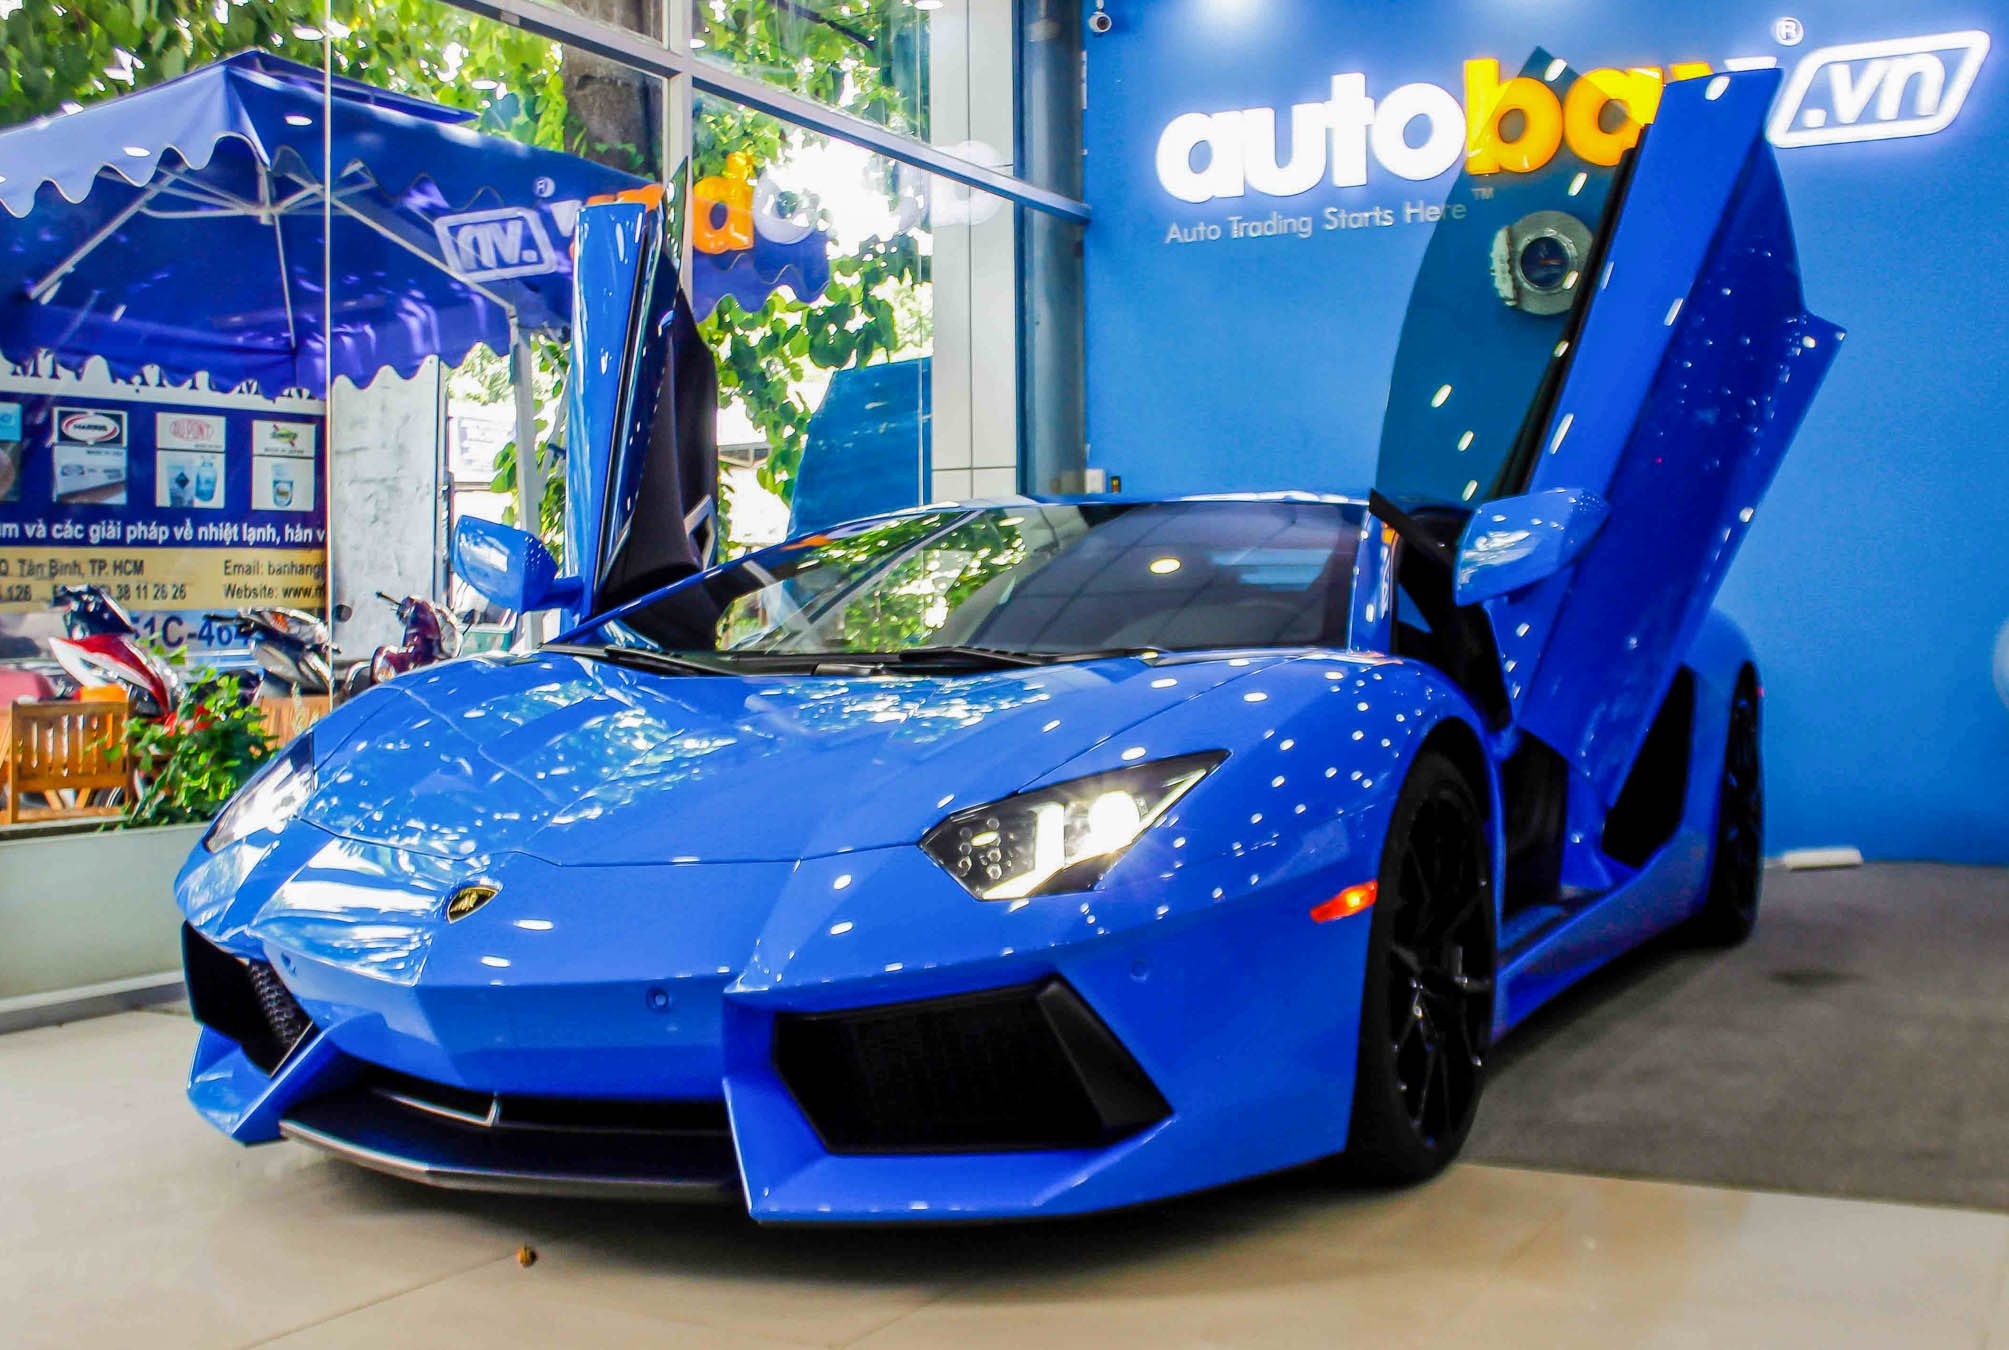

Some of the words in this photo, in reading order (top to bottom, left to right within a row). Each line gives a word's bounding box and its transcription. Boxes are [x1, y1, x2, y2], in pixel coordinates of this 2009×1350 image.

[1165, 222, 1222, 244] Auto
[1227, 211, 1313, 240] Trading
[1322, 205, 1394, 231] Starts
[1403, 201, 1468, 224] Here
[52, 518, 85, 540] các
[89, 519, 122, 544] giải
[126, 519, 170, 544] pháp
[198, 521, 239, 546] nhiệt
[113, 559, 145, 577] HCM
[224, 559, 264, 577] Email:
[224, 583, 278, 600] Website:
